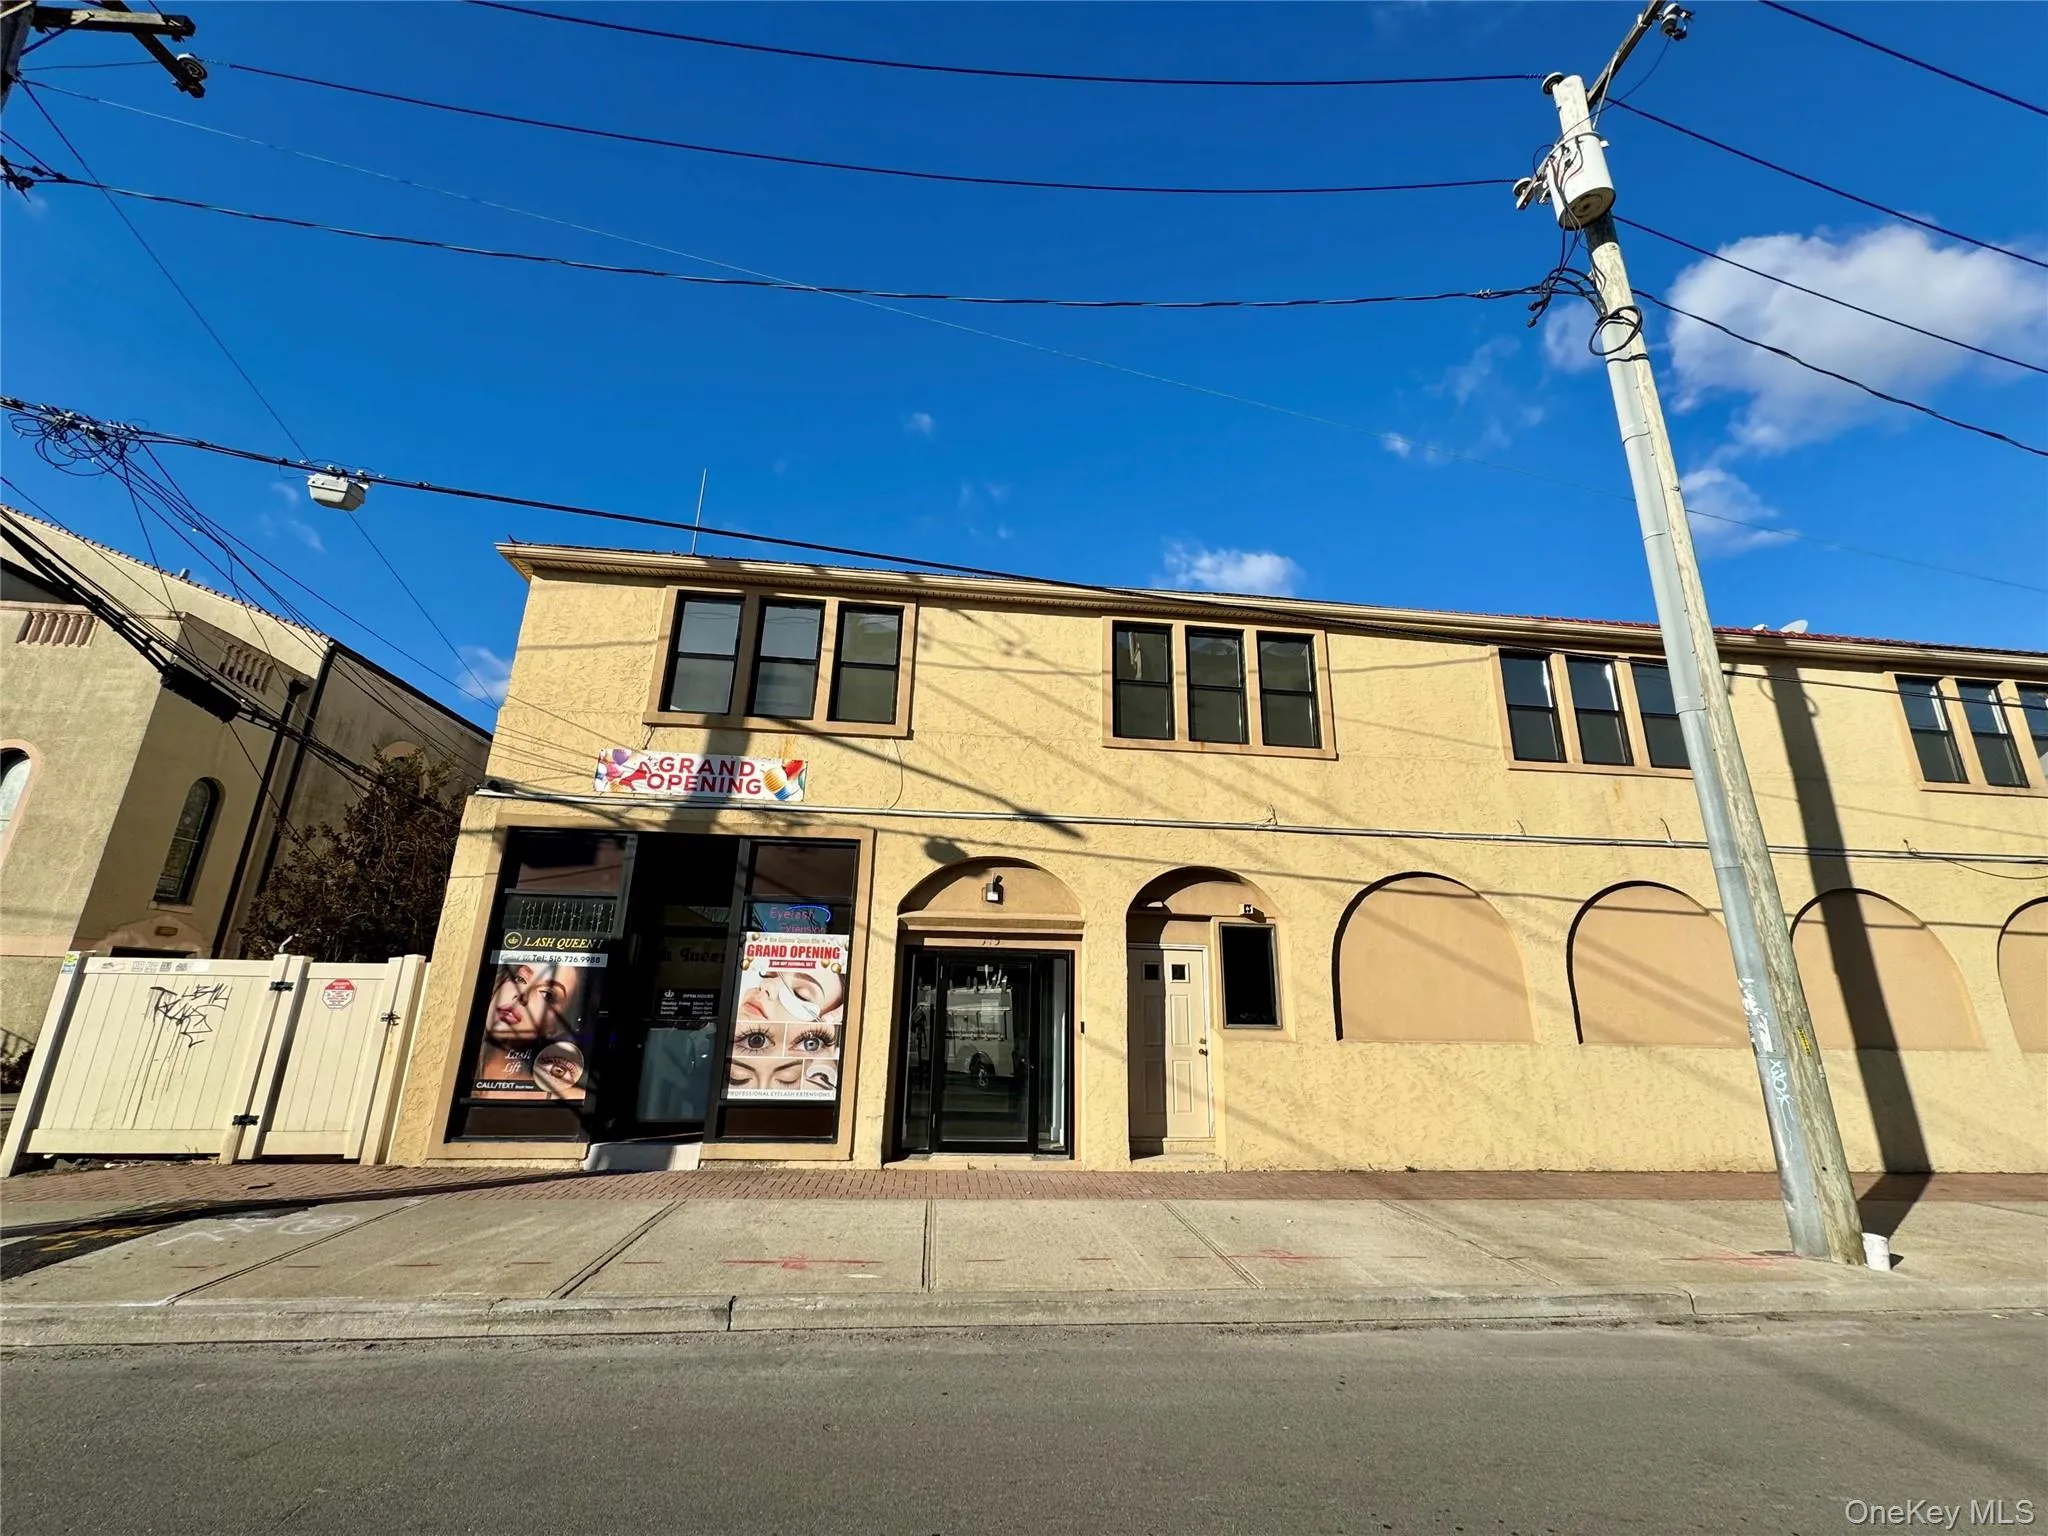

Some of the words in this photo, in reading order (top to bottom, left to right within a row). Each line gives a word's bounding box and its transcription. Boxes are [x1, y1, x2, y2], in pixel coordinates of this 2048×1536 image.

[658, 756, 755, 777] GRAND
[646, 773, 762, 795] OPENING
[769, 907, 816, 921] Eyelash
[524, 937, 556, 948] LASH
[556, 938, 597, 950] QUEEN
[747, 944, 787, 958] GRAND
[790, 945, 840, 959] OPENING
[476, 1082, 515, 1090] CALL/TEXT
